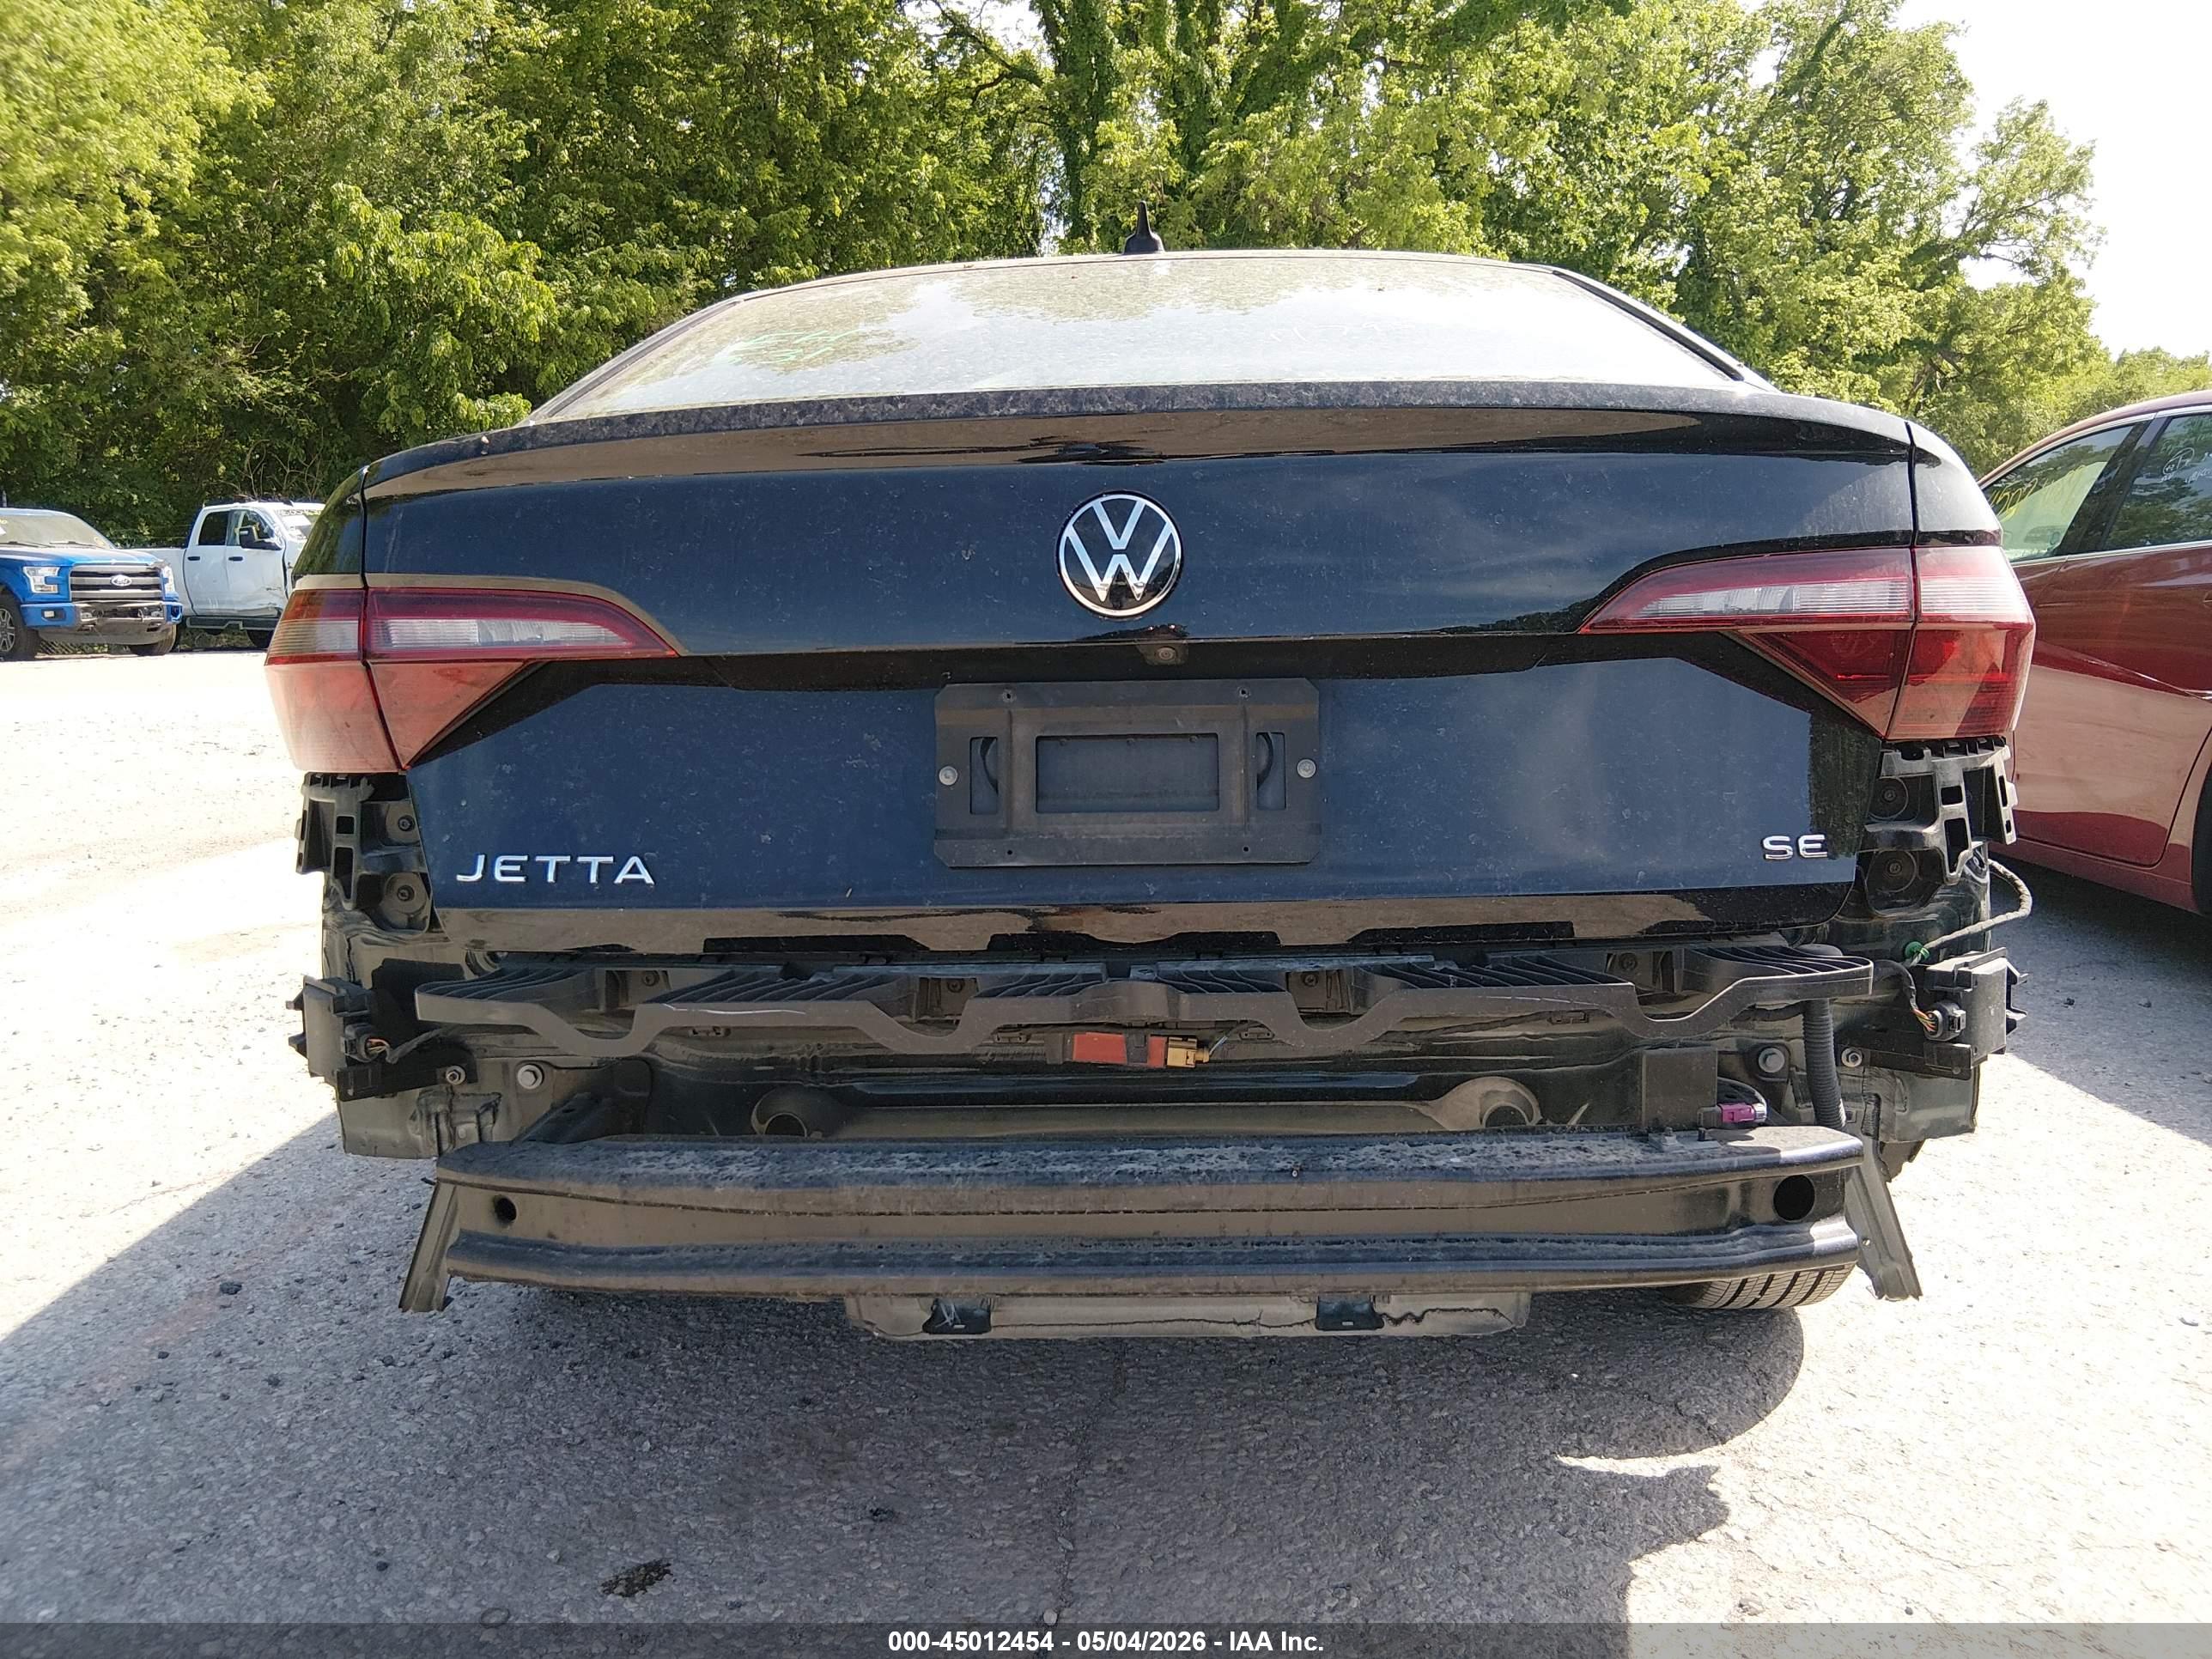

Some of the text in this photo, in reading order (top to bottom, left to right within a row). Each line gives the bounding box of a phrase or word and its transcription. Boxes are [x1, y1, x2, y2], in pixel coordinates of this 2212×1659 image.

[1060, 493, 1181, 610] VW
[1763, 835, 1828, 860] SE
[456, 854, 655, 885] JETTA
